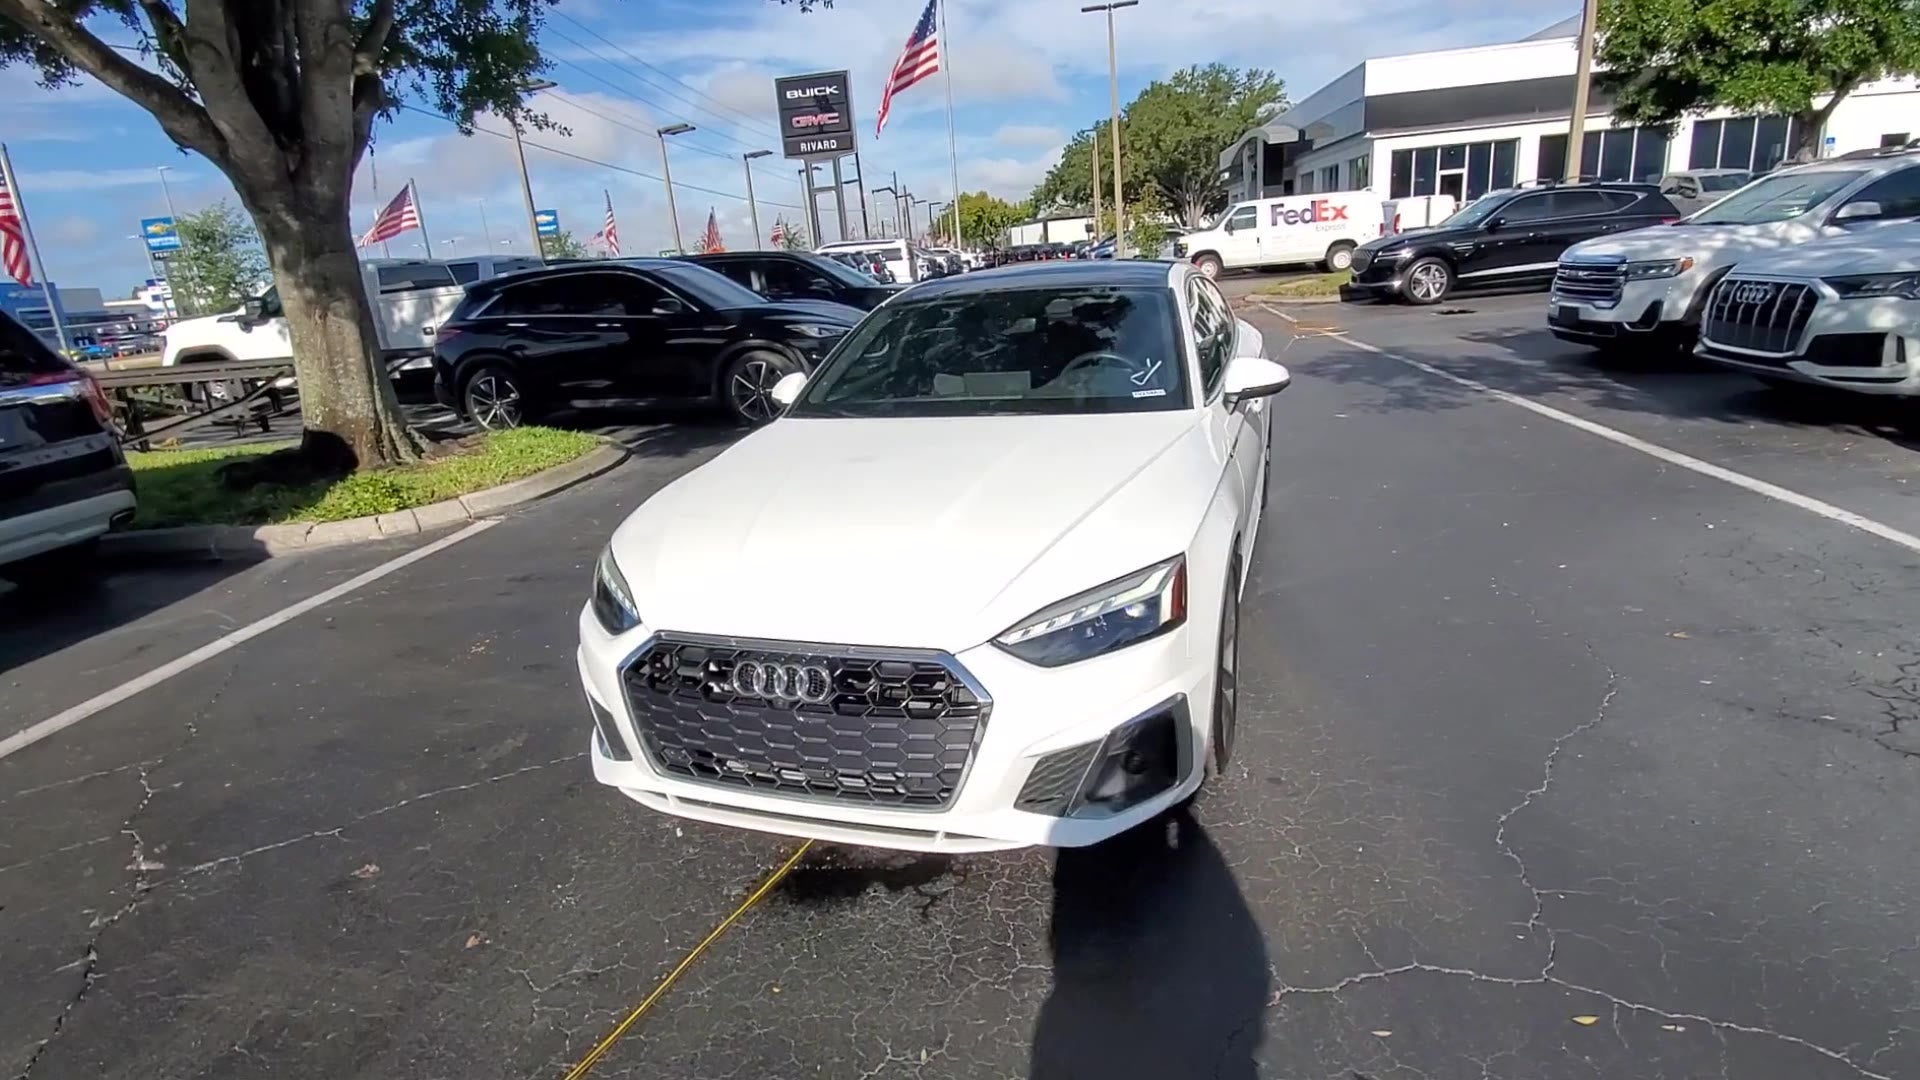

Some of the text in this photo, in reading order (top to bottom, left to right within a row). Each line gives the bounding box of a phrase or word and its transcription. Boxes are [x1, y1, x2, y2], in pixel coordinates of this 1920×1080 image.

[786, 85, 840, 99] BUICK
[792, 112, 840, 128] GMC
[800, 140, 837, 152] RIVARD
[1270, 199, 1349, 227] FedEx
